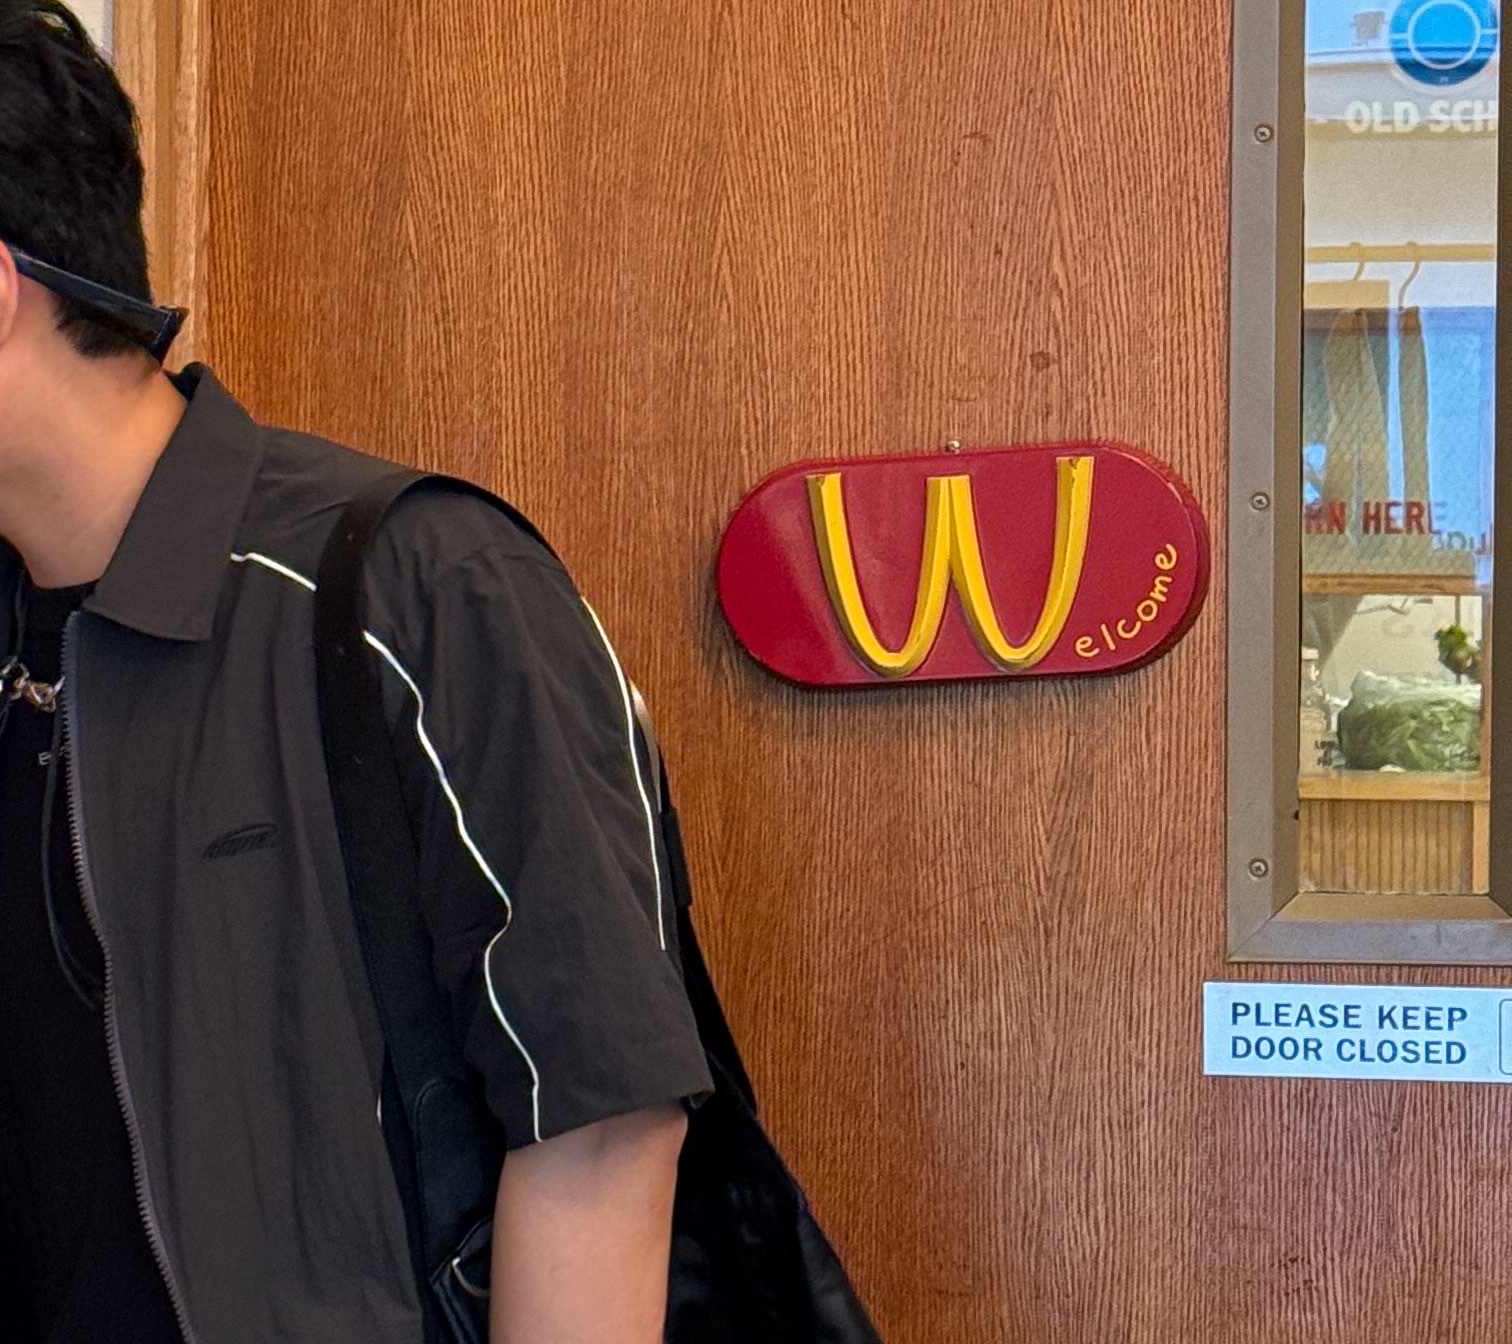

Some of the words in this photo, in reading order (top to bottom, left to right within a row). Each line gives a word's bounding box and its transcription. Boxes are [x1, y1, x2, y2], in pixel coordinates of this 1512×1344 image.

[1344, 100, 1419, 134] OLD
[1361, 500, 1449, 536] HERE
[1231, 1002, 1362, 1029] PLEASE
[1378, 1005, 1467, 1031] KEEP
[1231, 1035, 1323, 1062] DOOR
[1336, 1038, 1467, 1065] CLOSED
